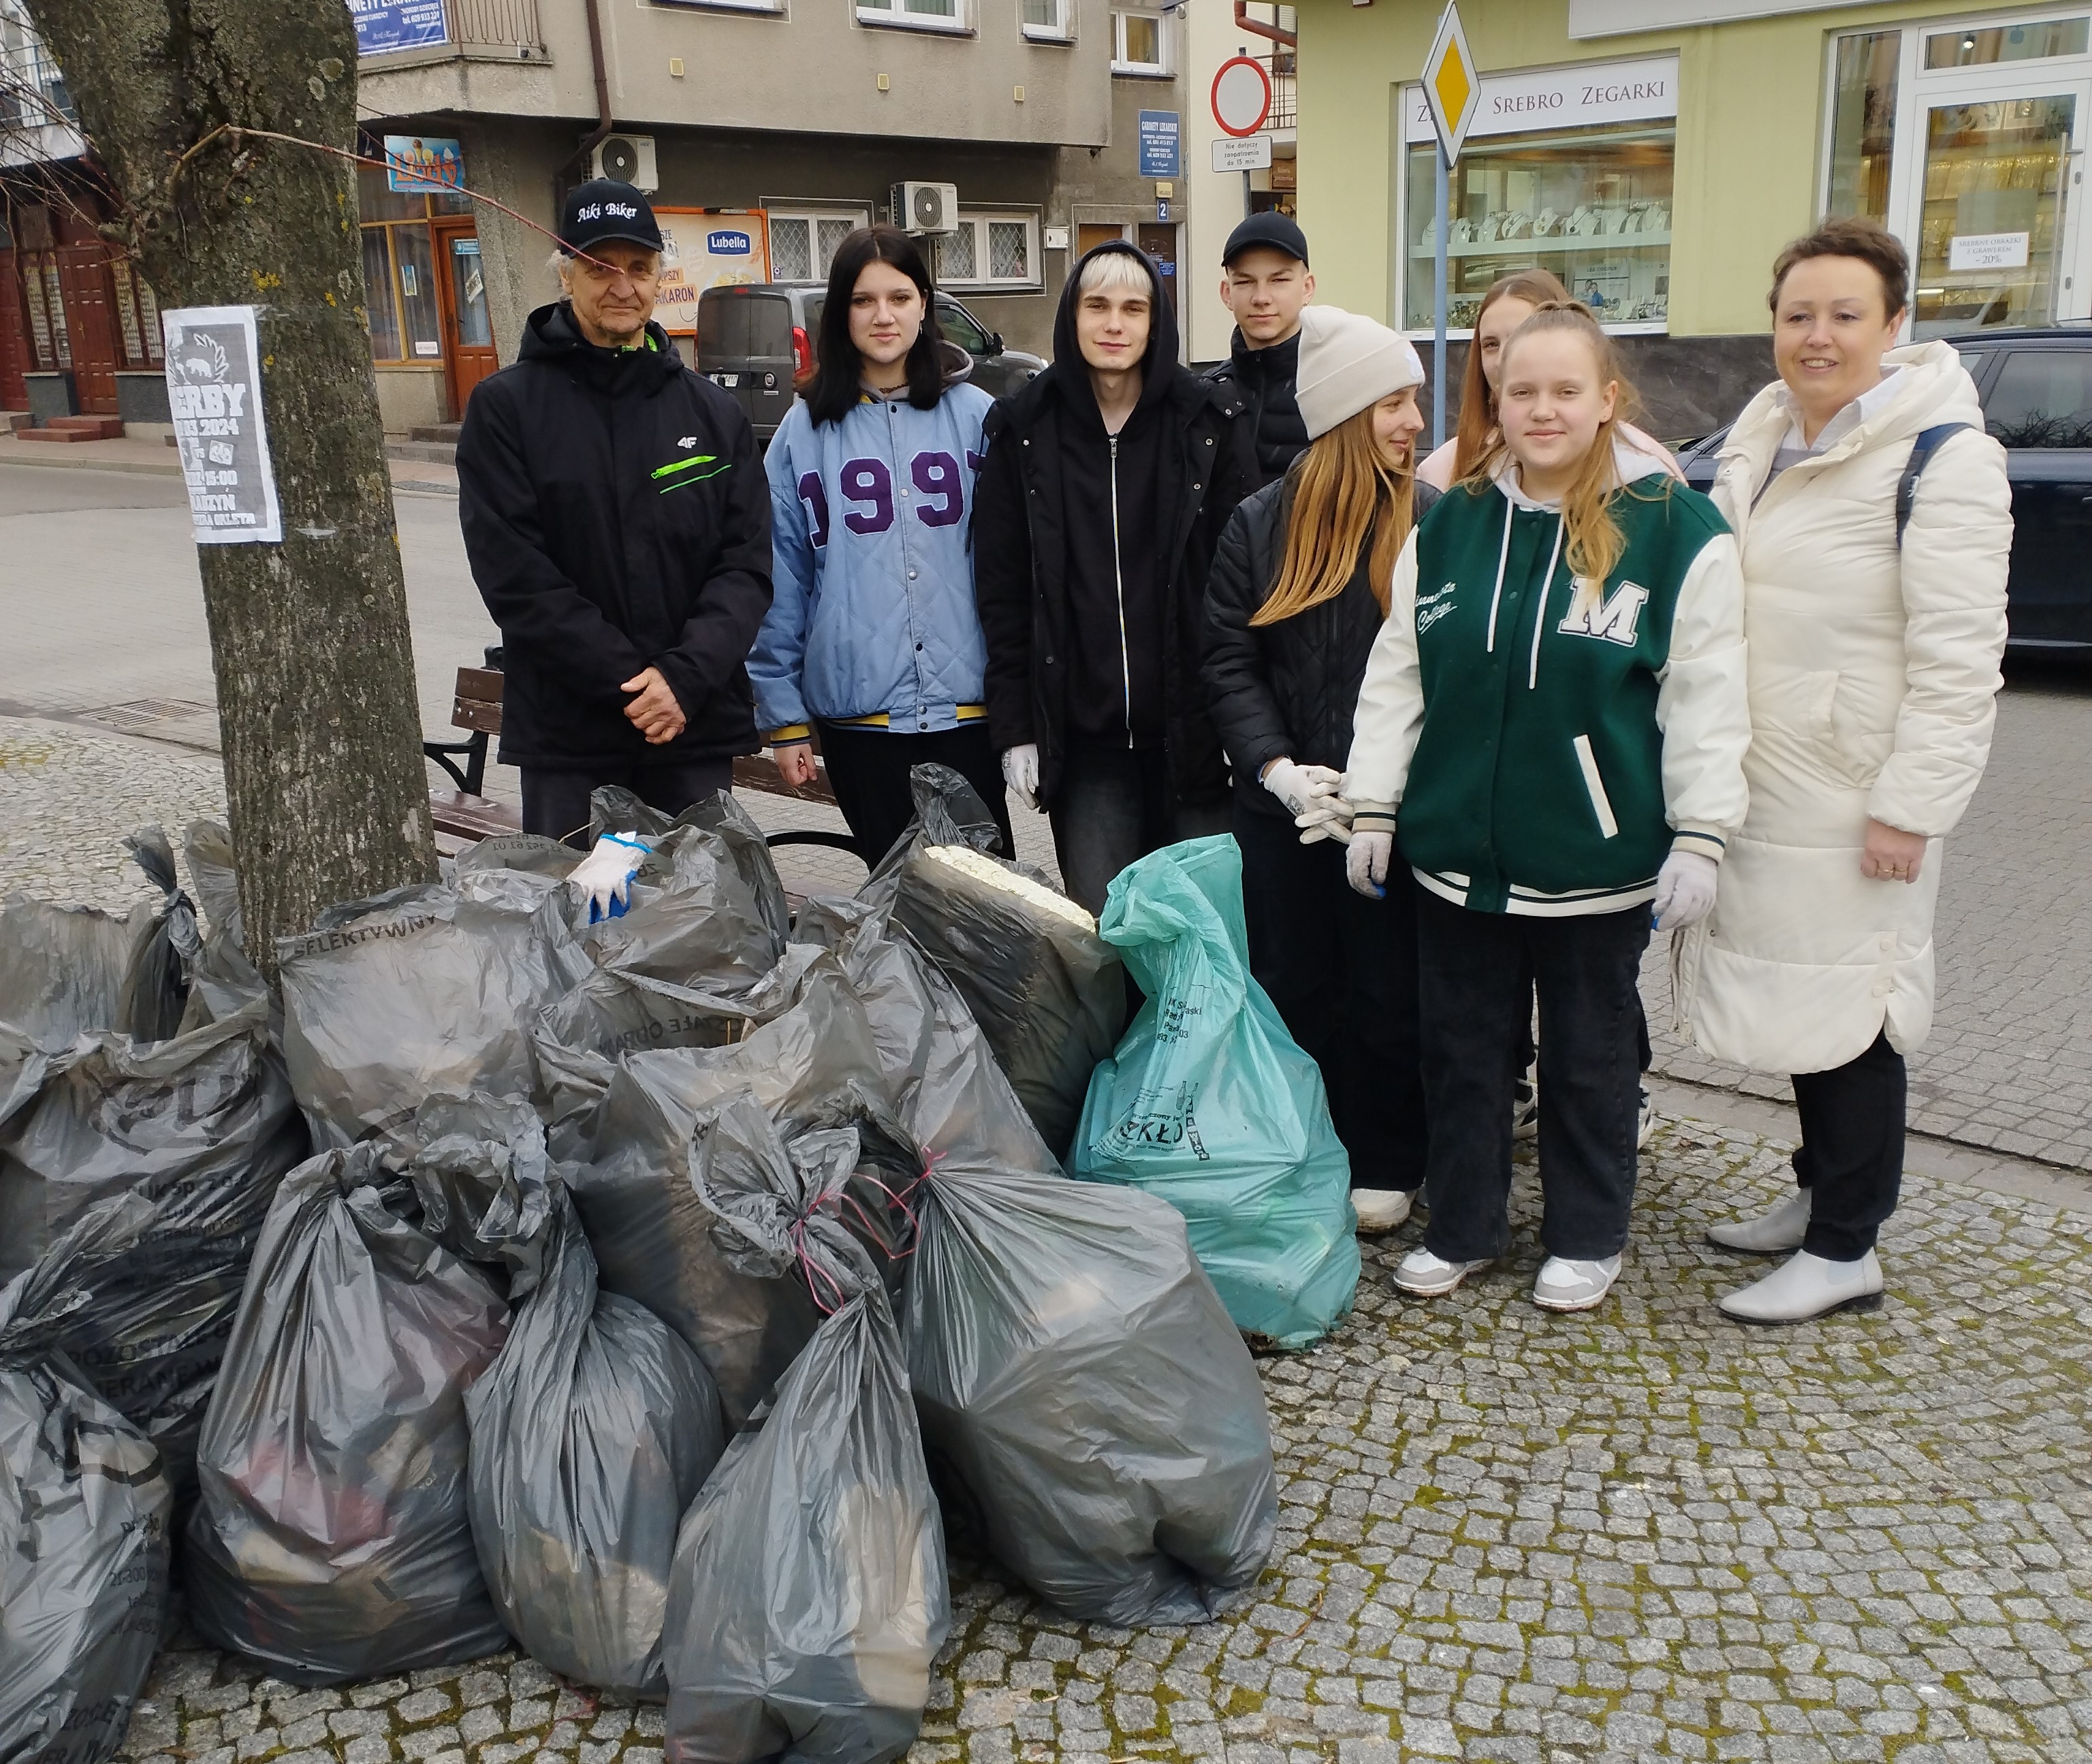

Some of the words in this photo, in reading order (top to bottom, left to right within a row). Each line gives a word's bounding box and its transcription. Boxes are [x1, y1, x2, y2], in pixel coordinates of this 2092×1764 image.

[1493, 92, 1564, 114] SREBRO
[1581, 80, 1665, 106] ZEGARKI
[577, 203, 601, 223] Aiki
[605, 202, 637, 219] Biker
[1160, 203, 1167, 217] 2
[711, 235, 747, 249] Lubella
[1959, 239, 1988, 247] SREBRNE
[1991, 237, 2021, 245] OBRAZKI
[1972, 246, 2012, 254] GRAWEREM
[677, 436, 697, 449] 4F
[1557, 576, 1650, 647] M
